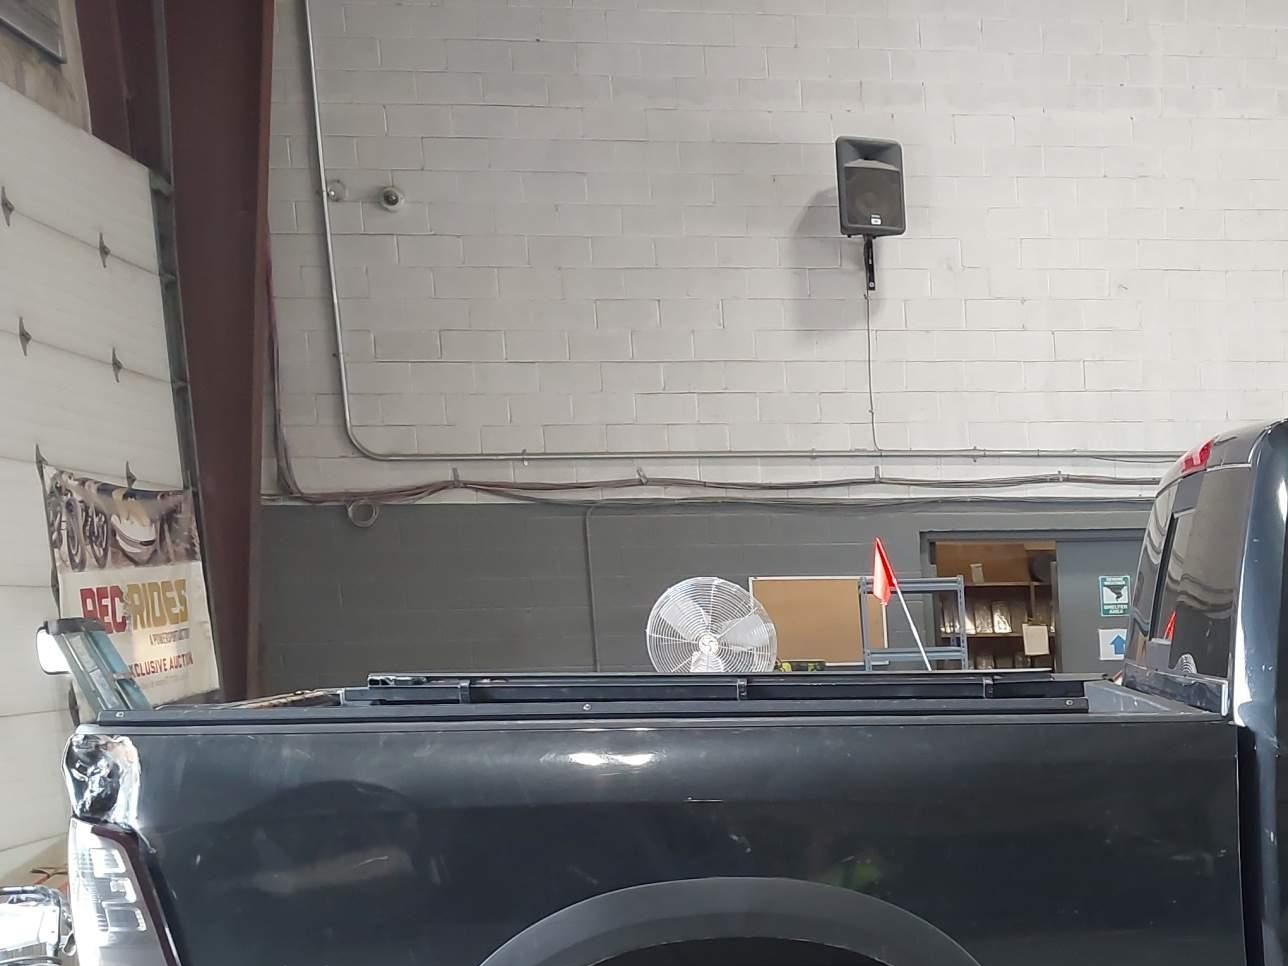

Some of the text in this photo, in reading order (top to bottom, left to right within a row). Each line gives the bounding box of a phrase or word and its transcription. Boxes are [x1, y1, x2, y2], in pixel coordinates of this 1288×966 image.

[80, 579, 188, 634] REC RIDES
[128, 657, 168, 678] XCLUSIVE
